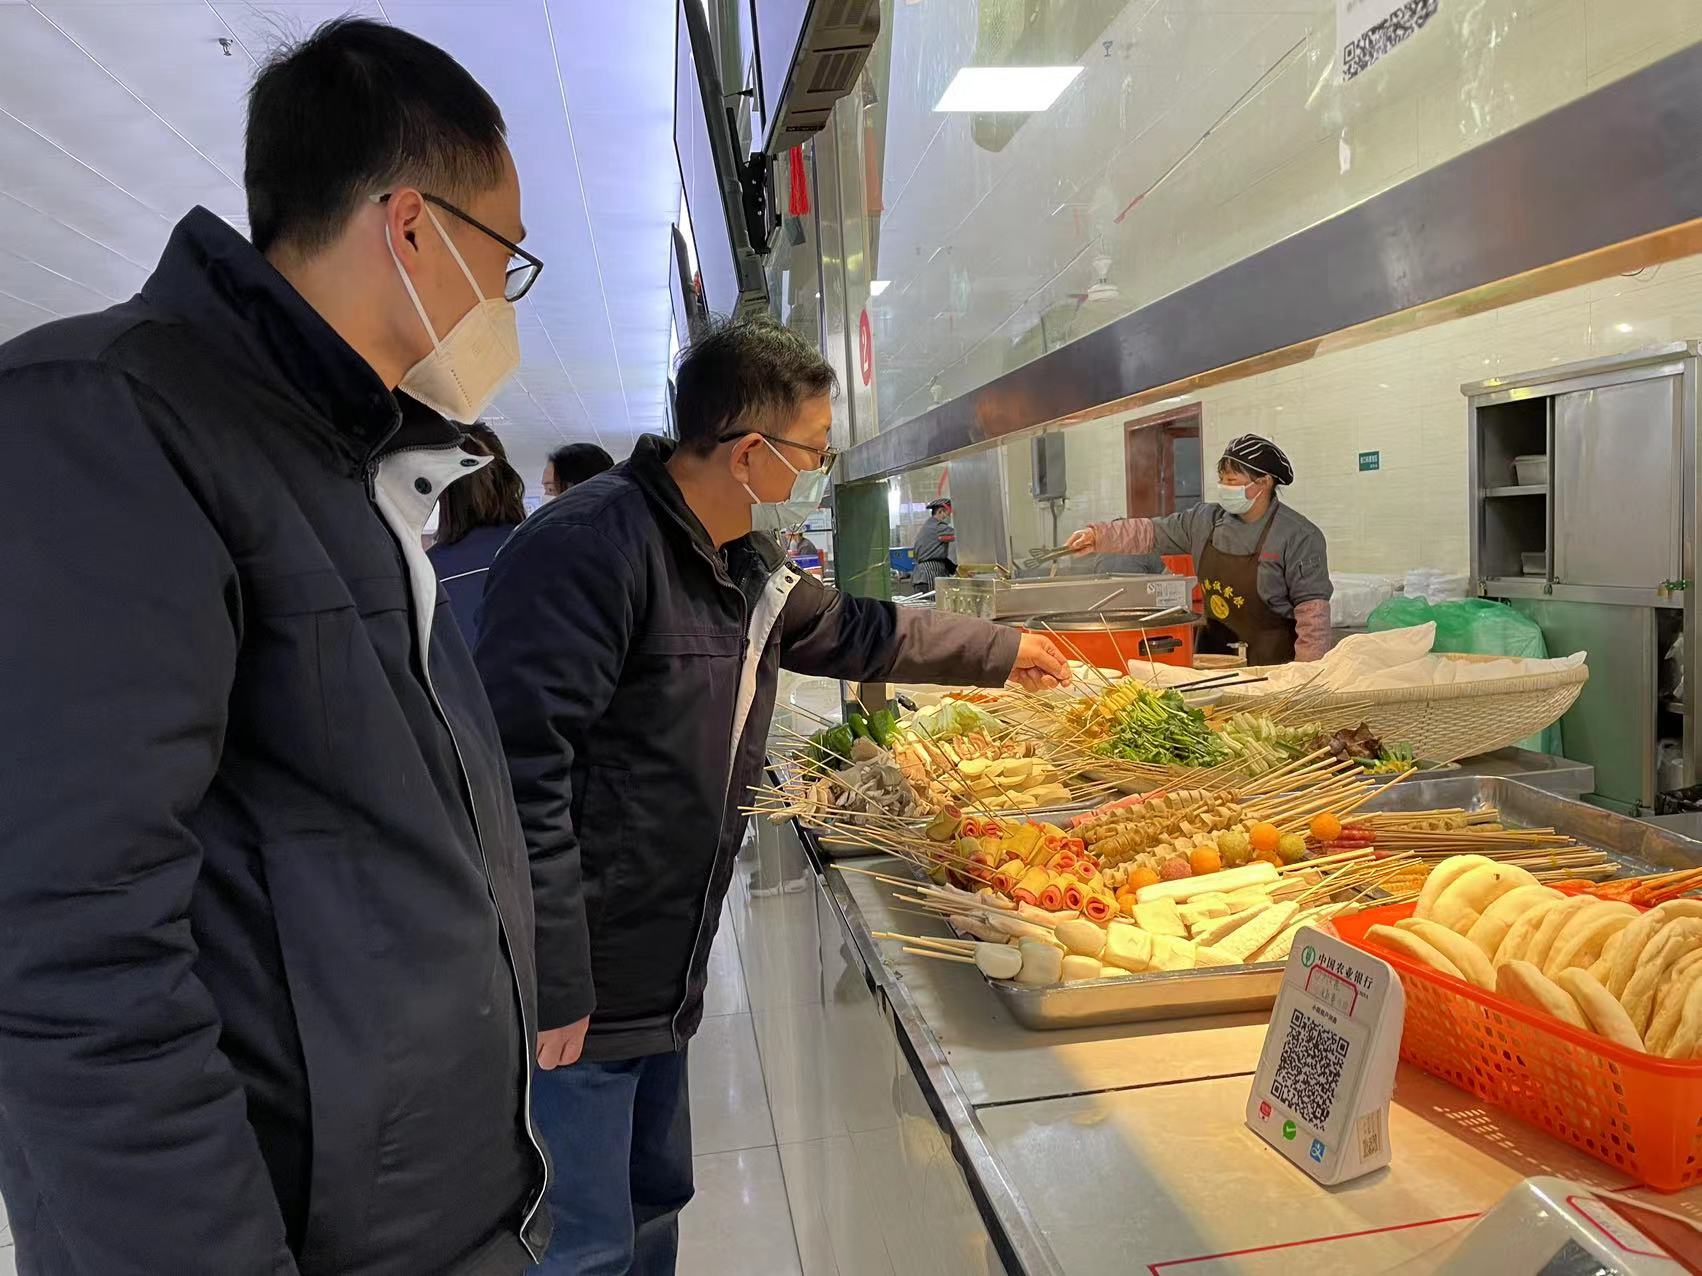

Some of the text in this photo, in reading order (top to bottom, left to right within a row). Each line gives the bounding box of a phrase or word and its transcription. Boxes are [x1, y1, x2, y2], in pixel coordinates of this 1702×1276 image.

[861, 325, 869, 374] 2
[1318, 953, 1374, 990] 中国农业银行
